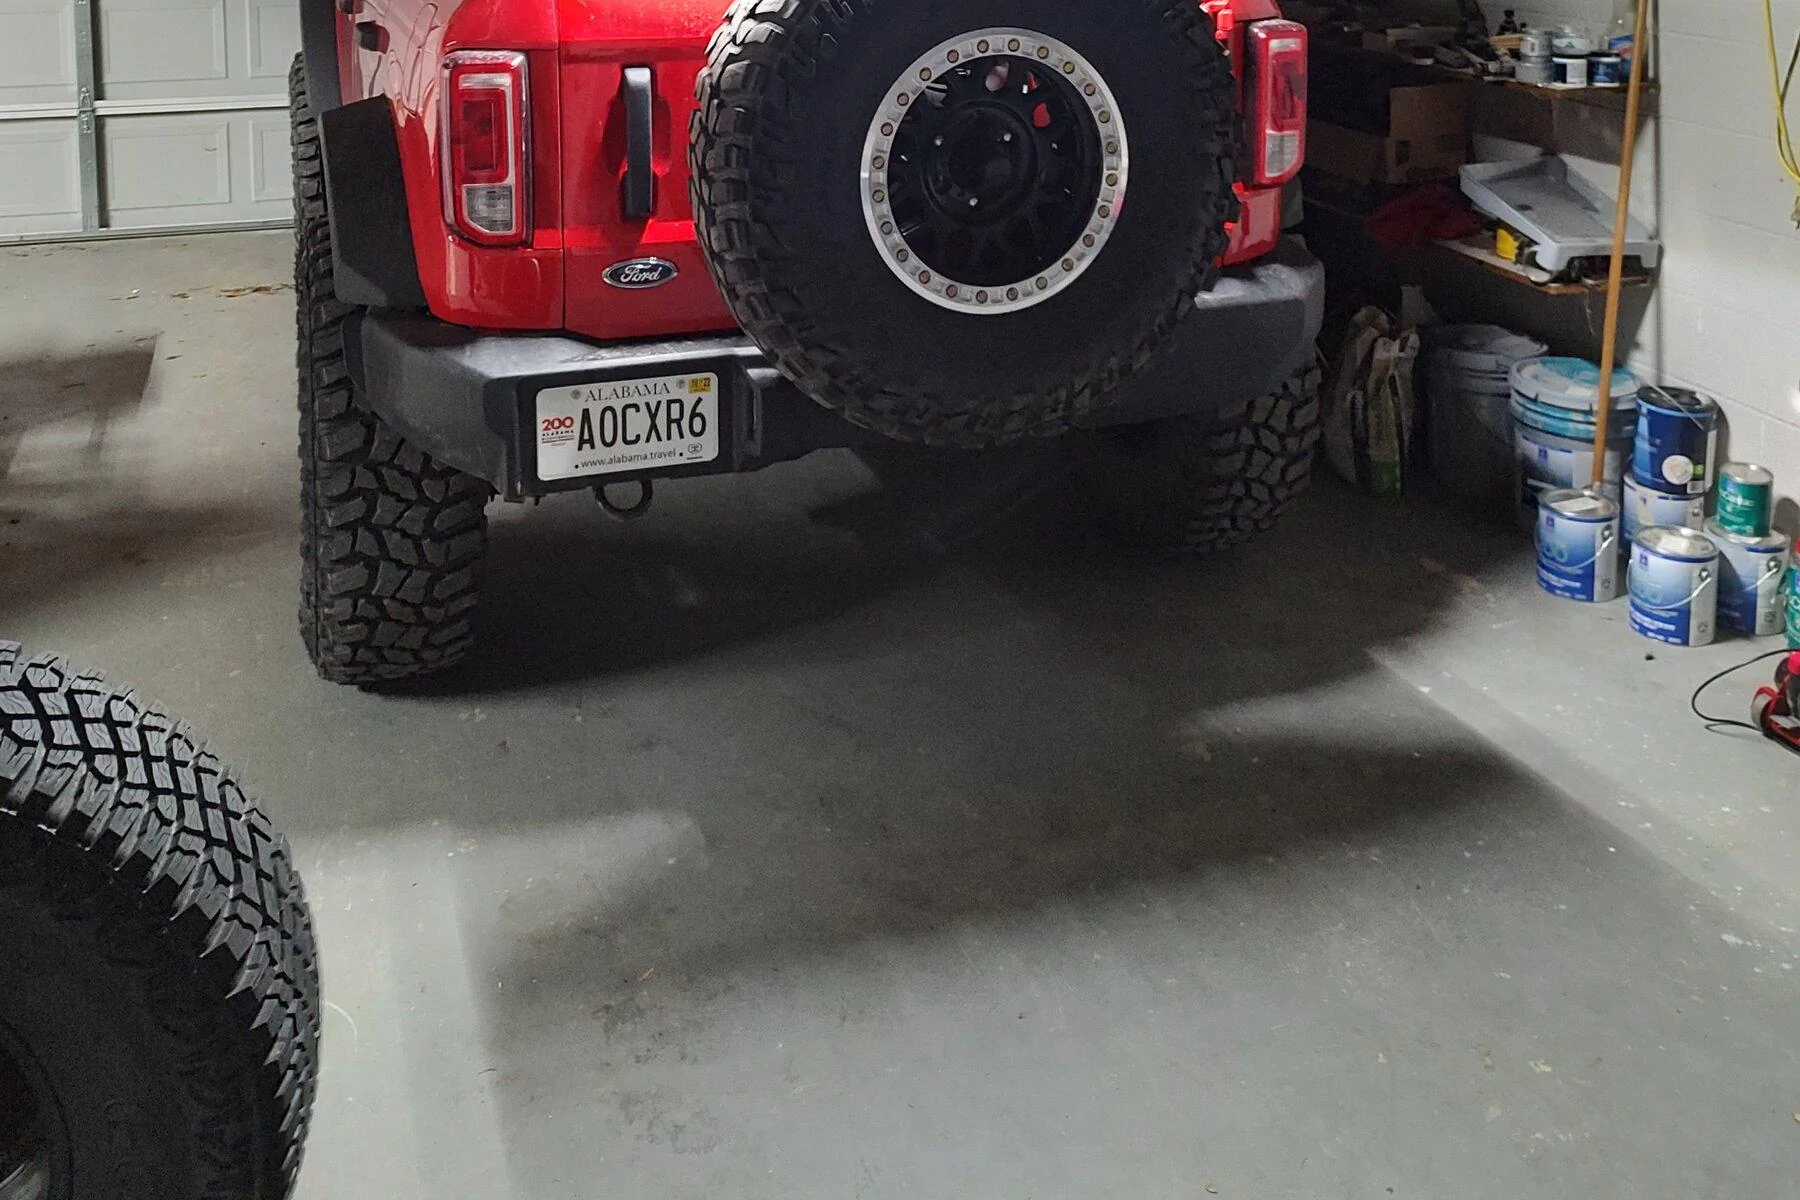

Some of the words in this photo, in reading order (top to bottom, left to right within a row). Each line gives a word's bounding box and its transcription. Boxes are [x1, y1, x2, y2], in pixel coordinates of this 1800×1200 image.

[620, 264, 662, 282] Ford
[585, 382, 671, 402] ALABAMA
[541, 416, 575, 431] 200
[581, 448, 676, 469] www.alabama.travel
